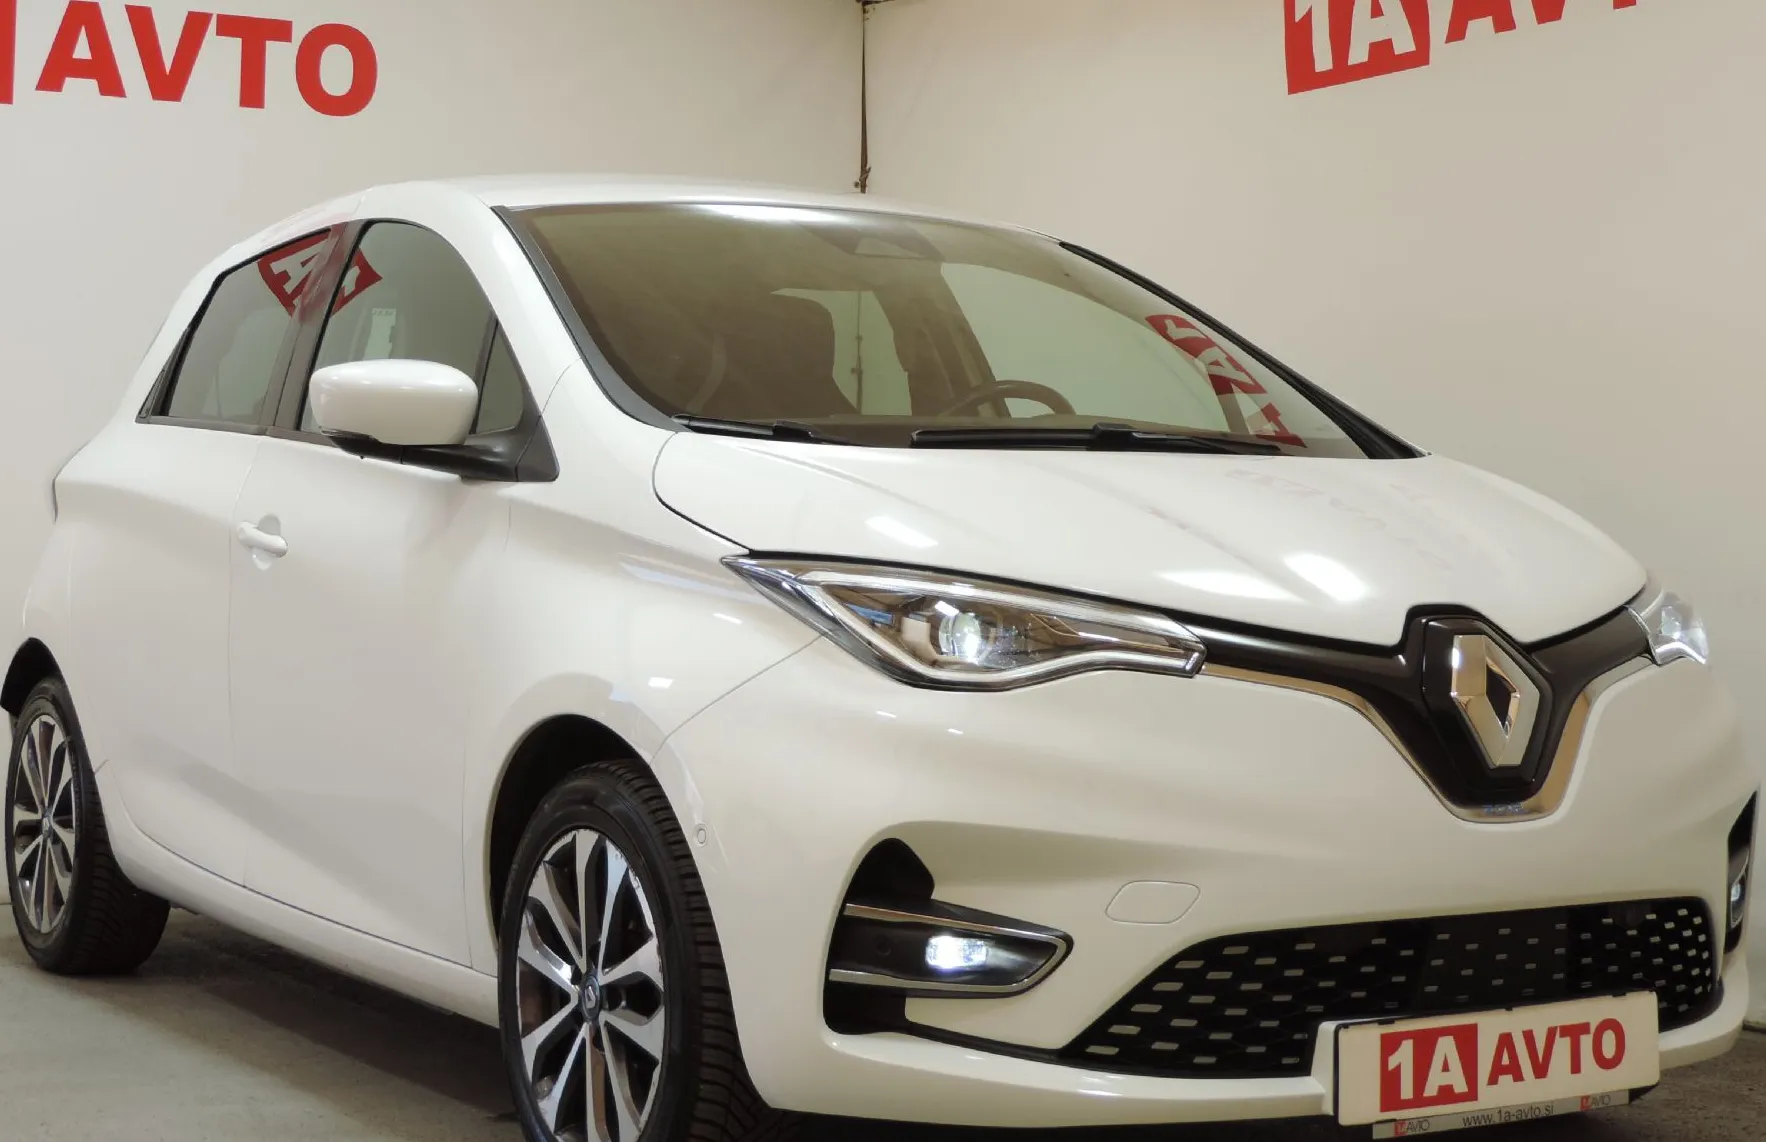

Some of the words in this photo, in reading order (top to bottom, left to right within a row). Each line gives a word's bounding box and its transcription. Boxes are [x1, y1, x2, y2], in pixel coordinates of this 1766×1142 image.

[35, 0, 378, 117] AVTO
[1387, 1035, 1469, 1100] 1A
[1486, 1017, 1626, 1086] AVTO
